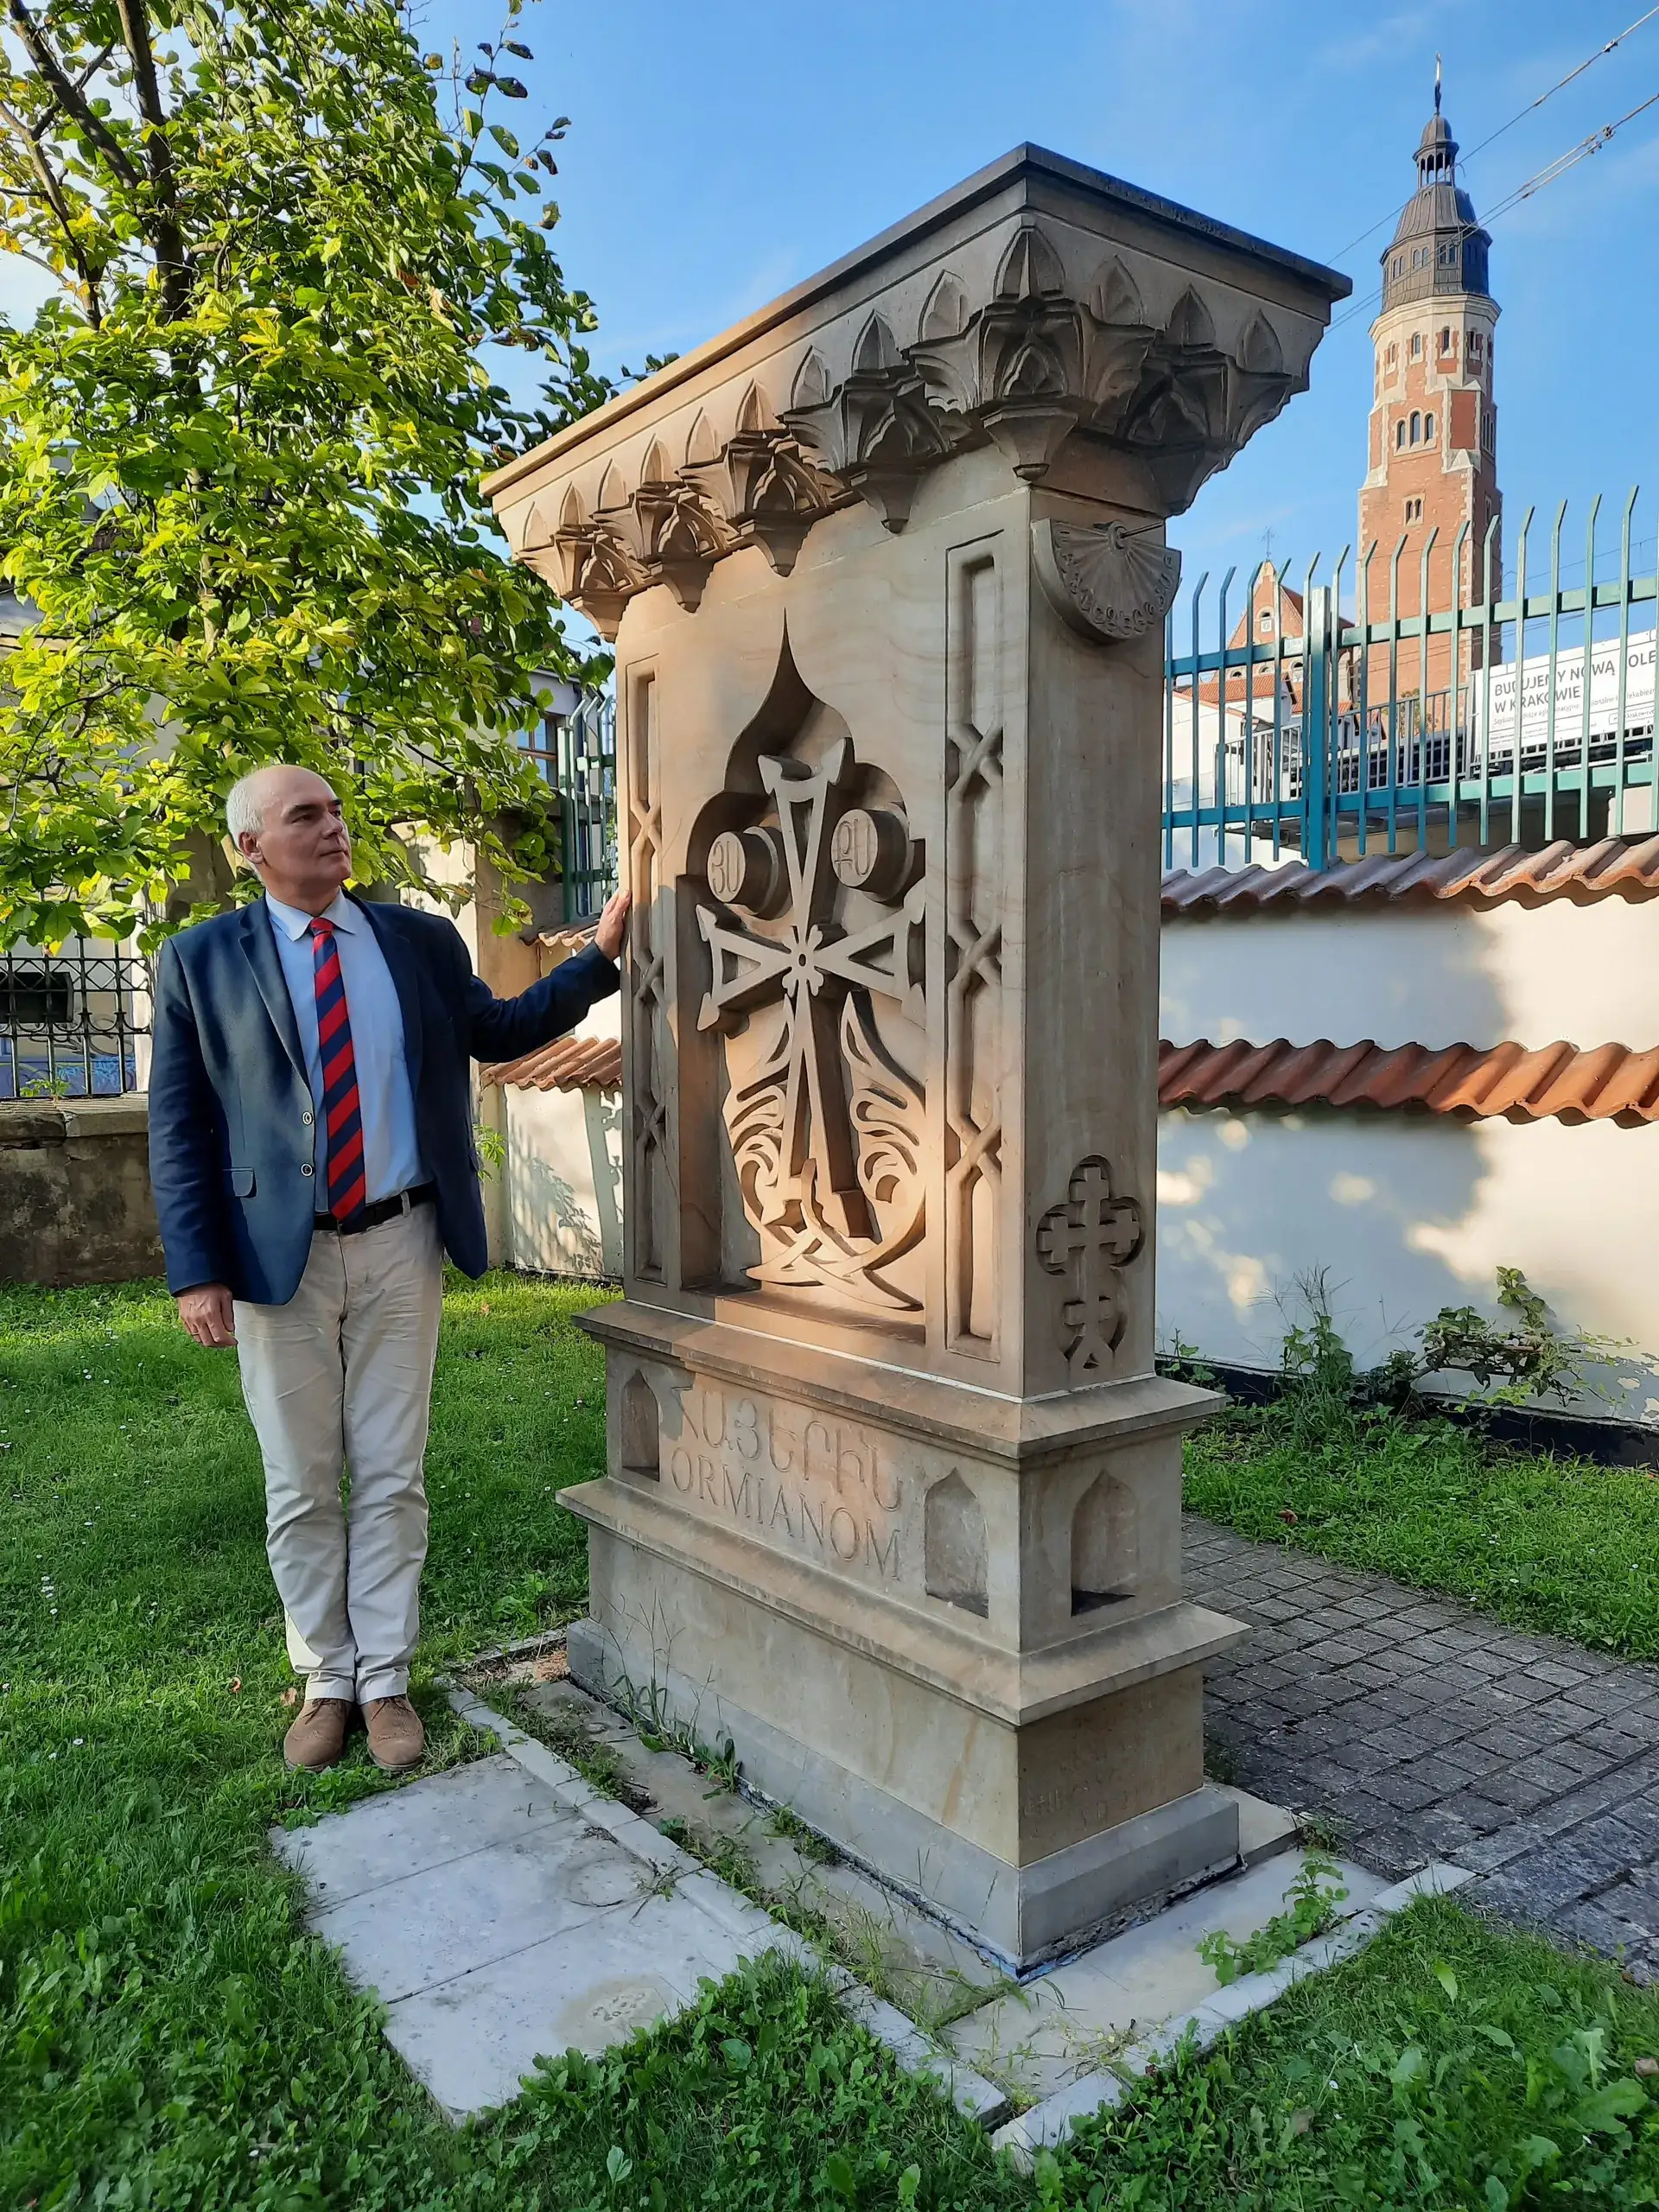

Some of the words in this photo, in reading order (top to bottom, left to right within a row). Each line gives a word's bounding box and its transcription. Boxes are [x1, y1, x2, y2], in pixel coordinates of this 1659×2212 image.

[1628, 650, 1656, 668] OLE
[1495, 700, 1506, 714] W
[671, 1446, 902, 1581] ORMIANOM
